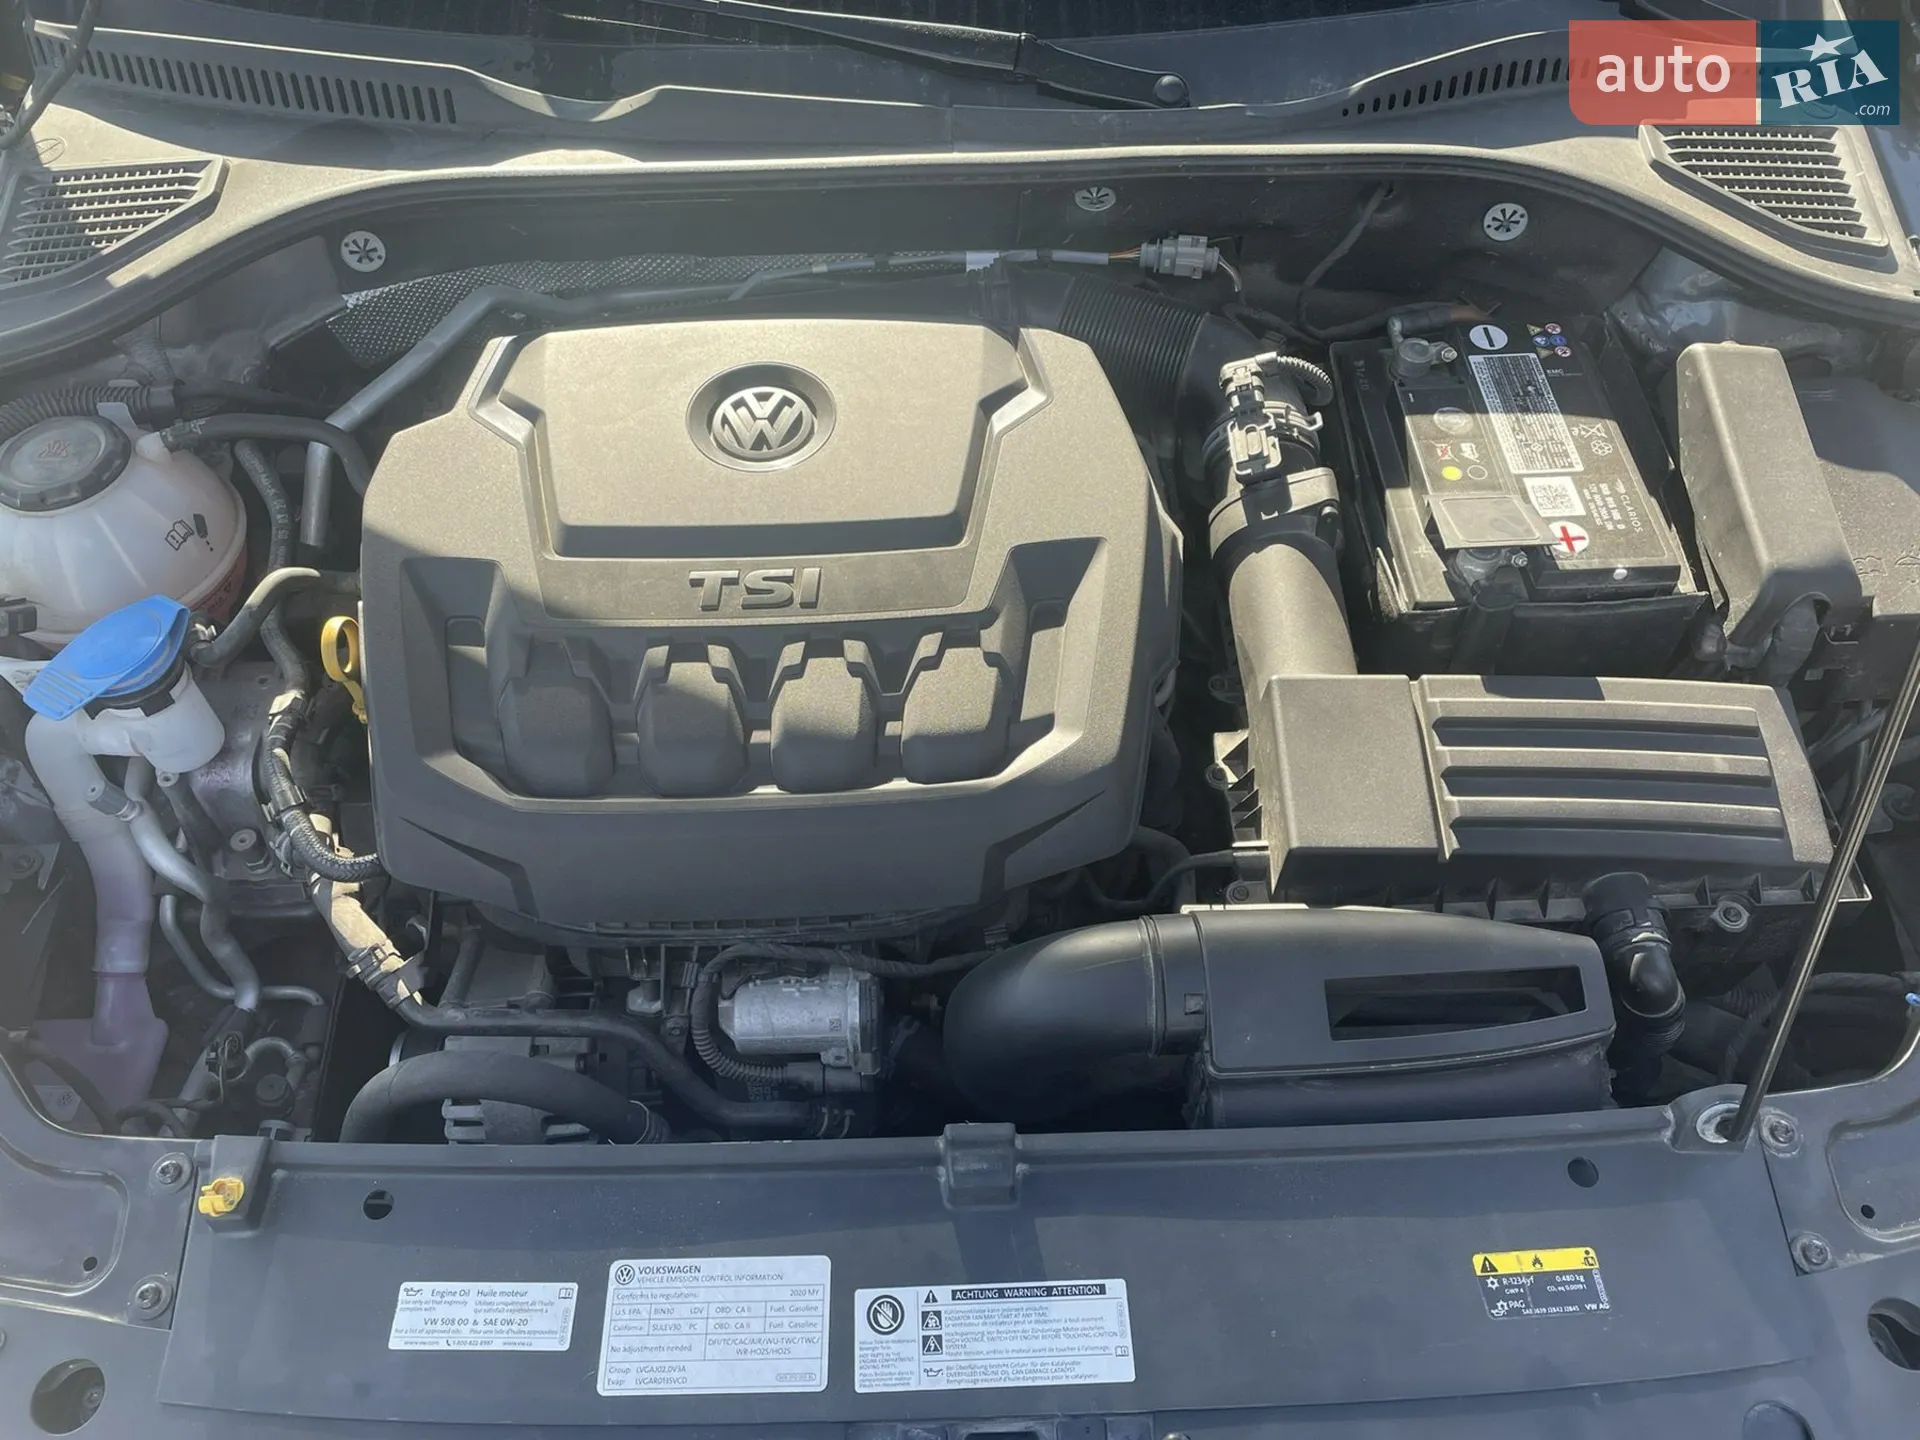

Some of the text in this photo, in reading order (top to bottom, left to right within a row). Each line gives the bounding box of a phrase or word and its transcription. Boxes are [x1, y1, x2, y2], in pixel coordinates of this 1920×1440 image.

[1621, 494, 1643, 532] CLARIOS
[689, 567, 822, 611] TSI
[638, 1265, 701, 1274] VOLKSWAGEN
[1502, 1276, 1534, 1286] R-1234yf
[956, 1286, 1100, 1299] ACHTUNG WARNING ATTENTION
[1509, 1300, 1525, 1308] PAG
[622, 1344, 663, 1353] adjustments
